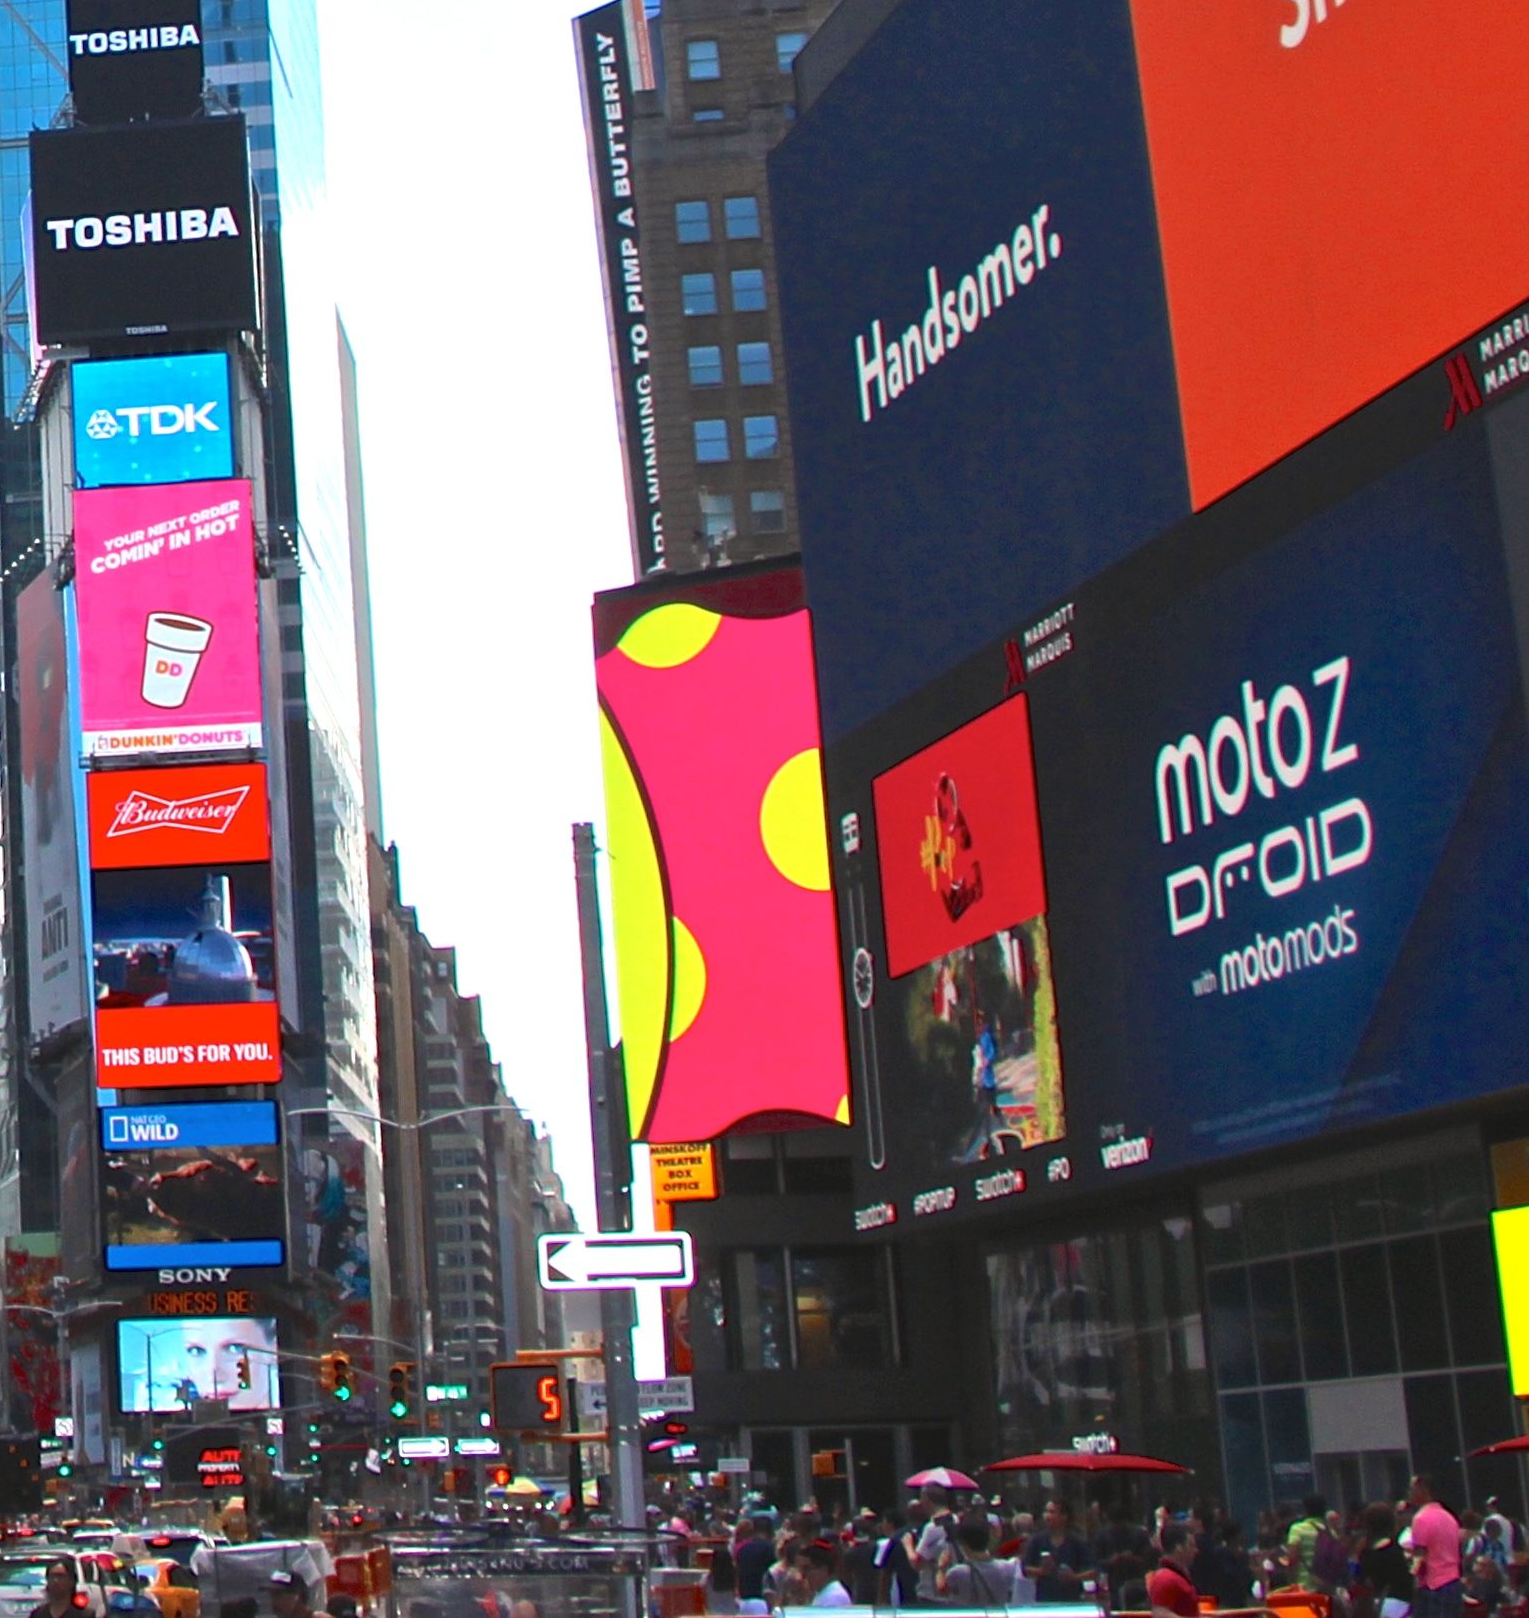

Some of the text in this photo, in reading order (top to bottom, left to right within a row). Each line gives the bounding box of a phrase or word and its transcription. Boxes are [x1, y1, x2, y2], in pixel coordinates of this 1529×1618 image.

[68, 23, 200, 58] TOSHIBA
[595, 31, 633, 199] BUTTERFLY
[46, 204, 240, 252] TOSHIBA
[616, 206, 637, 228] A
[620, 237, 645, 316] PIMP
[855, 203, 1063, 422] Handsomer.
[631, 322, 652, 364] TO
[117, 400, 220, 438] TDK
[103, 498, 241, 551] YOUR NEXT ORDER
[90, 513, 241, 575] COMIN' IN HOT
[1023, 602, 1076, 648] MARRIOTT
[155, 659, 183, 678] DD
[1025, 632, 1073, 672] MARQUIS
[1154, 680, 1312, 845] moto
[115, 797, 242, 826] Budweiser
[1192, 970, 1218, 996] with
[102, 1041, 273, 1067] THIS BUD'S FOR YOU.
[130, 1123, 179, 1143] WILD
[656, 1156, 703, 1168] THEATRE
[1100, 1135, 1150, 1169] verizon
[662, 1181, 700, 1192] OFFICE
[668, 1169, 693, 1180] BOX
[974, 1167, 1015, 1201] swatch
[158, 1267, 232, 1284] SONY
